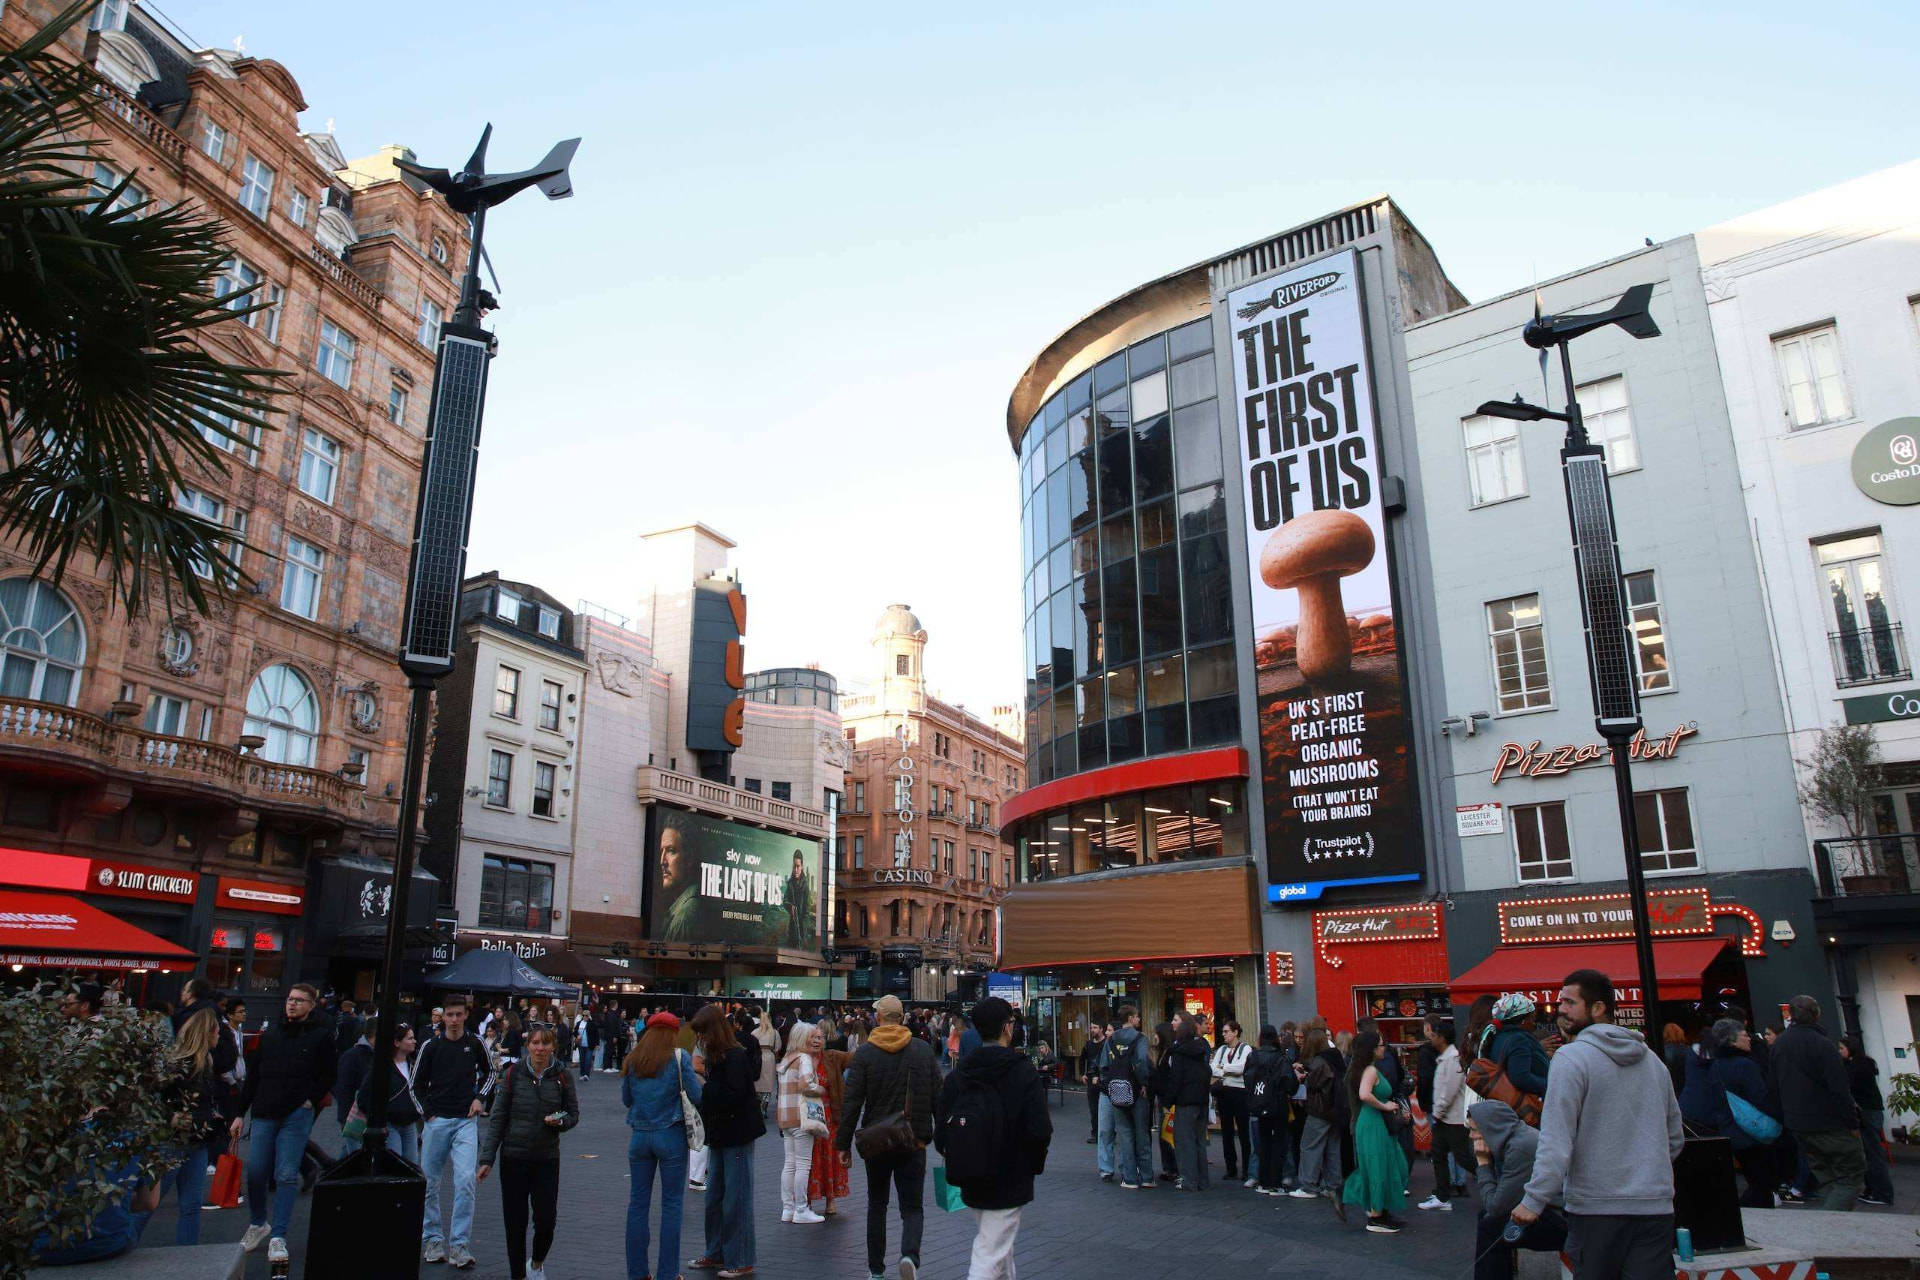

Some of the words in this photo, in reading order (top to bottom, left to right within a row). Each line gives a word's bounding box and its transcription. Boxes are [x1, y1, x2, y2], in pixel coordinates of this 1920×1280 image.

[1276, 274, 1336, 308] RIVERFORD
[1237, 307, 1315, 391] THE
[1244, 363, 1359, 461] FIRST
[1250, 454, 1300, 532] OF
[1308, 436, 1371, 510] US
[1871, 468, 1910, 484] Costo
[1288, 698, 1321, 720] UK'S
[1324, 691, 1365, 714] FIRST
[1291, 714, 1366, 742] PEAT-FREE
[1301, 738, 1363, 763] ORGANIC
[1491, 739, 1601, 785] Pizza
[1289, 759, 1379, 788] MUSHROOMS
[1293, 793, 1322, 809] (THAT
[1325, 789, 1357, 806] WON'T
[1359, 786, 1379, 801] EAT
[1301, 807, 1328, 823] YOUR
[1330, 803, 1372, 820] BRAINS)
[1460, 812, 1491, 821] LEICESTER
[1461, 821, 1484, 829] SQUARE
[1315, 835, 1361, 849] Trustpilot
[726, 848, 741, 865] sky
[744, 854, 761, 865] NOW
[117, 870, 145, 889] SLIM
[147, 873, 193, 895] CHICKENS
[701, 862, 722, 898] THE
[723, 866, 752, 902] LAST
[753, 872, 768, 904] OF
[767, 874, 782, 906] US
[874, 869, 933, 884] CASINO
[1279, 884, 1307, 899] global
[1323, 919, 1360, 935] Pizza
[1362, 918, 1391, 932] Hut
[1509, 914, 1544, 928] COME
[1546, 913, 1565, 926] ON
[1566, 912, 1580, 925] IN
[1581, 911, 1598, 924] TO
[1600, 909, 1634, 922] YOUR
[44, 956, 68, 965] CHICKEN
[515, 941, 547, 959] Italia
